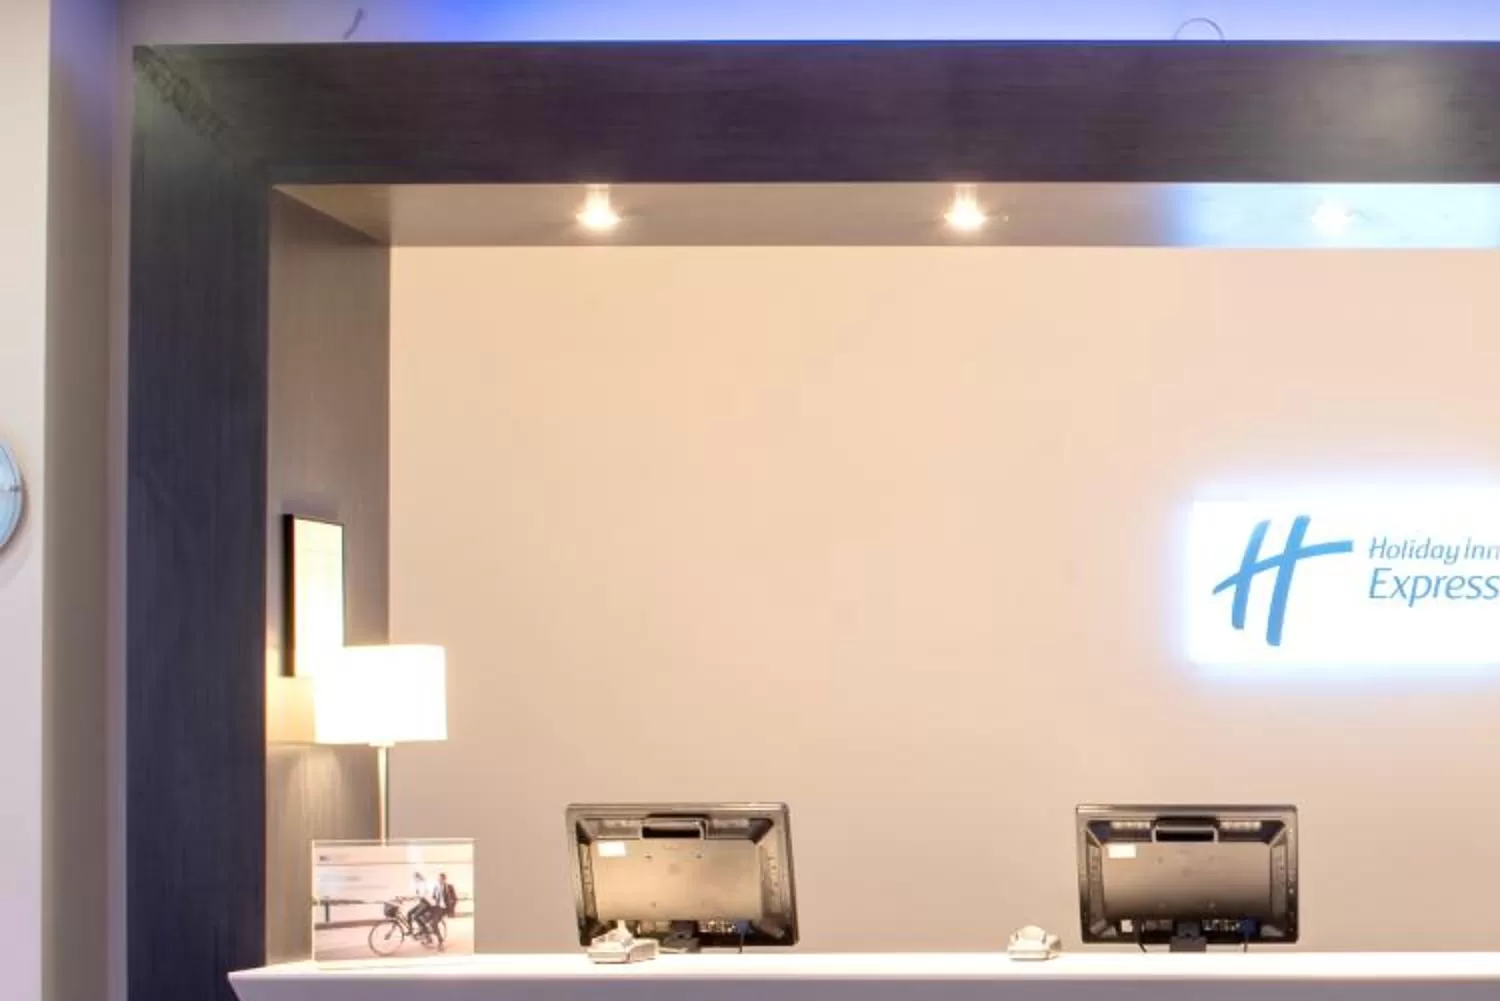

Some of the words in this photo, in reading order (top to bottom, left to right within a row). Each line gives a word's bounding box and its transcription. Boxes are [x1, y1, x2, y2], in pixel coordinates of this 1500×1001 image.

[1367, 536, 1460, 565] Holiday
[1463, 537, 1500, 560] Inn
[1367, 567, 1500, 608] Express
